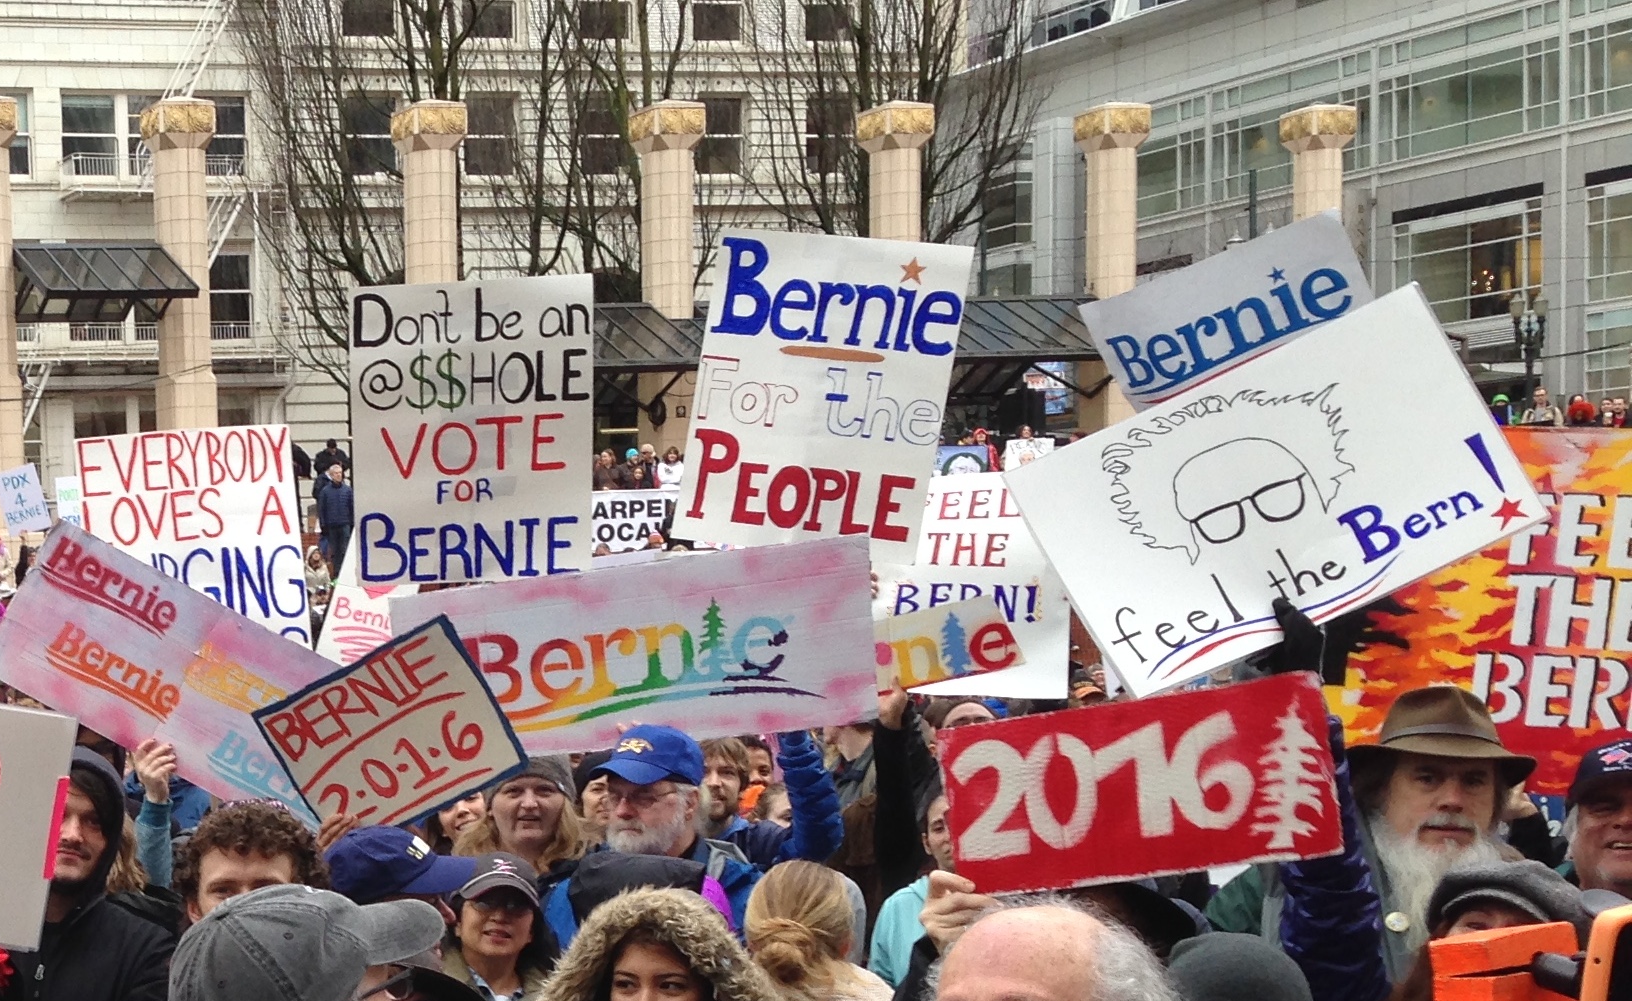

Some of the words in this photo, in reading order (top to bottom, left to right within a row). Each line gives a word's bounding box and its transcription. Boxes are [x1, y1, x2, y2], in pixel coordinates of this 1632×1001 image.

[475, 287, 523, 342] be
[539, 303, 591, 337] an
[710, 236, 964, 356] Bernie
[1106, 266, 1353, 389] Bernie
[359, 348, 591, 414] @$$HOLE
[697, 354, 799, 428] For
[824, 366, 941, 446] the
[2, 473, 30, 491] PDX
[77, 426, 287, 497] EVERYBODY
[381, 413, 566, 480] VOTE
[686, 428, 916, 543] PEOPLE
[15, 493, 27, 508] 4
[82, 487, 224, 545] LOVES
[256, 486, 291, 535] A
[436, 478, 493, 505] FOR
[45, 536, 178, 630] Bernie
[360, 512, 579, 582] BERNIE
[927, 532, 1009, 567] THE
[1111, 573, 1244, 663] feel
[1267, 547, 1347, 602] the
[49, 621, 181, 715] Bernie
[462, 602, 792, 705] Bernie
[264, 634, 449, 762] BERNIE
[947, 709, 1258, 864] 2016
